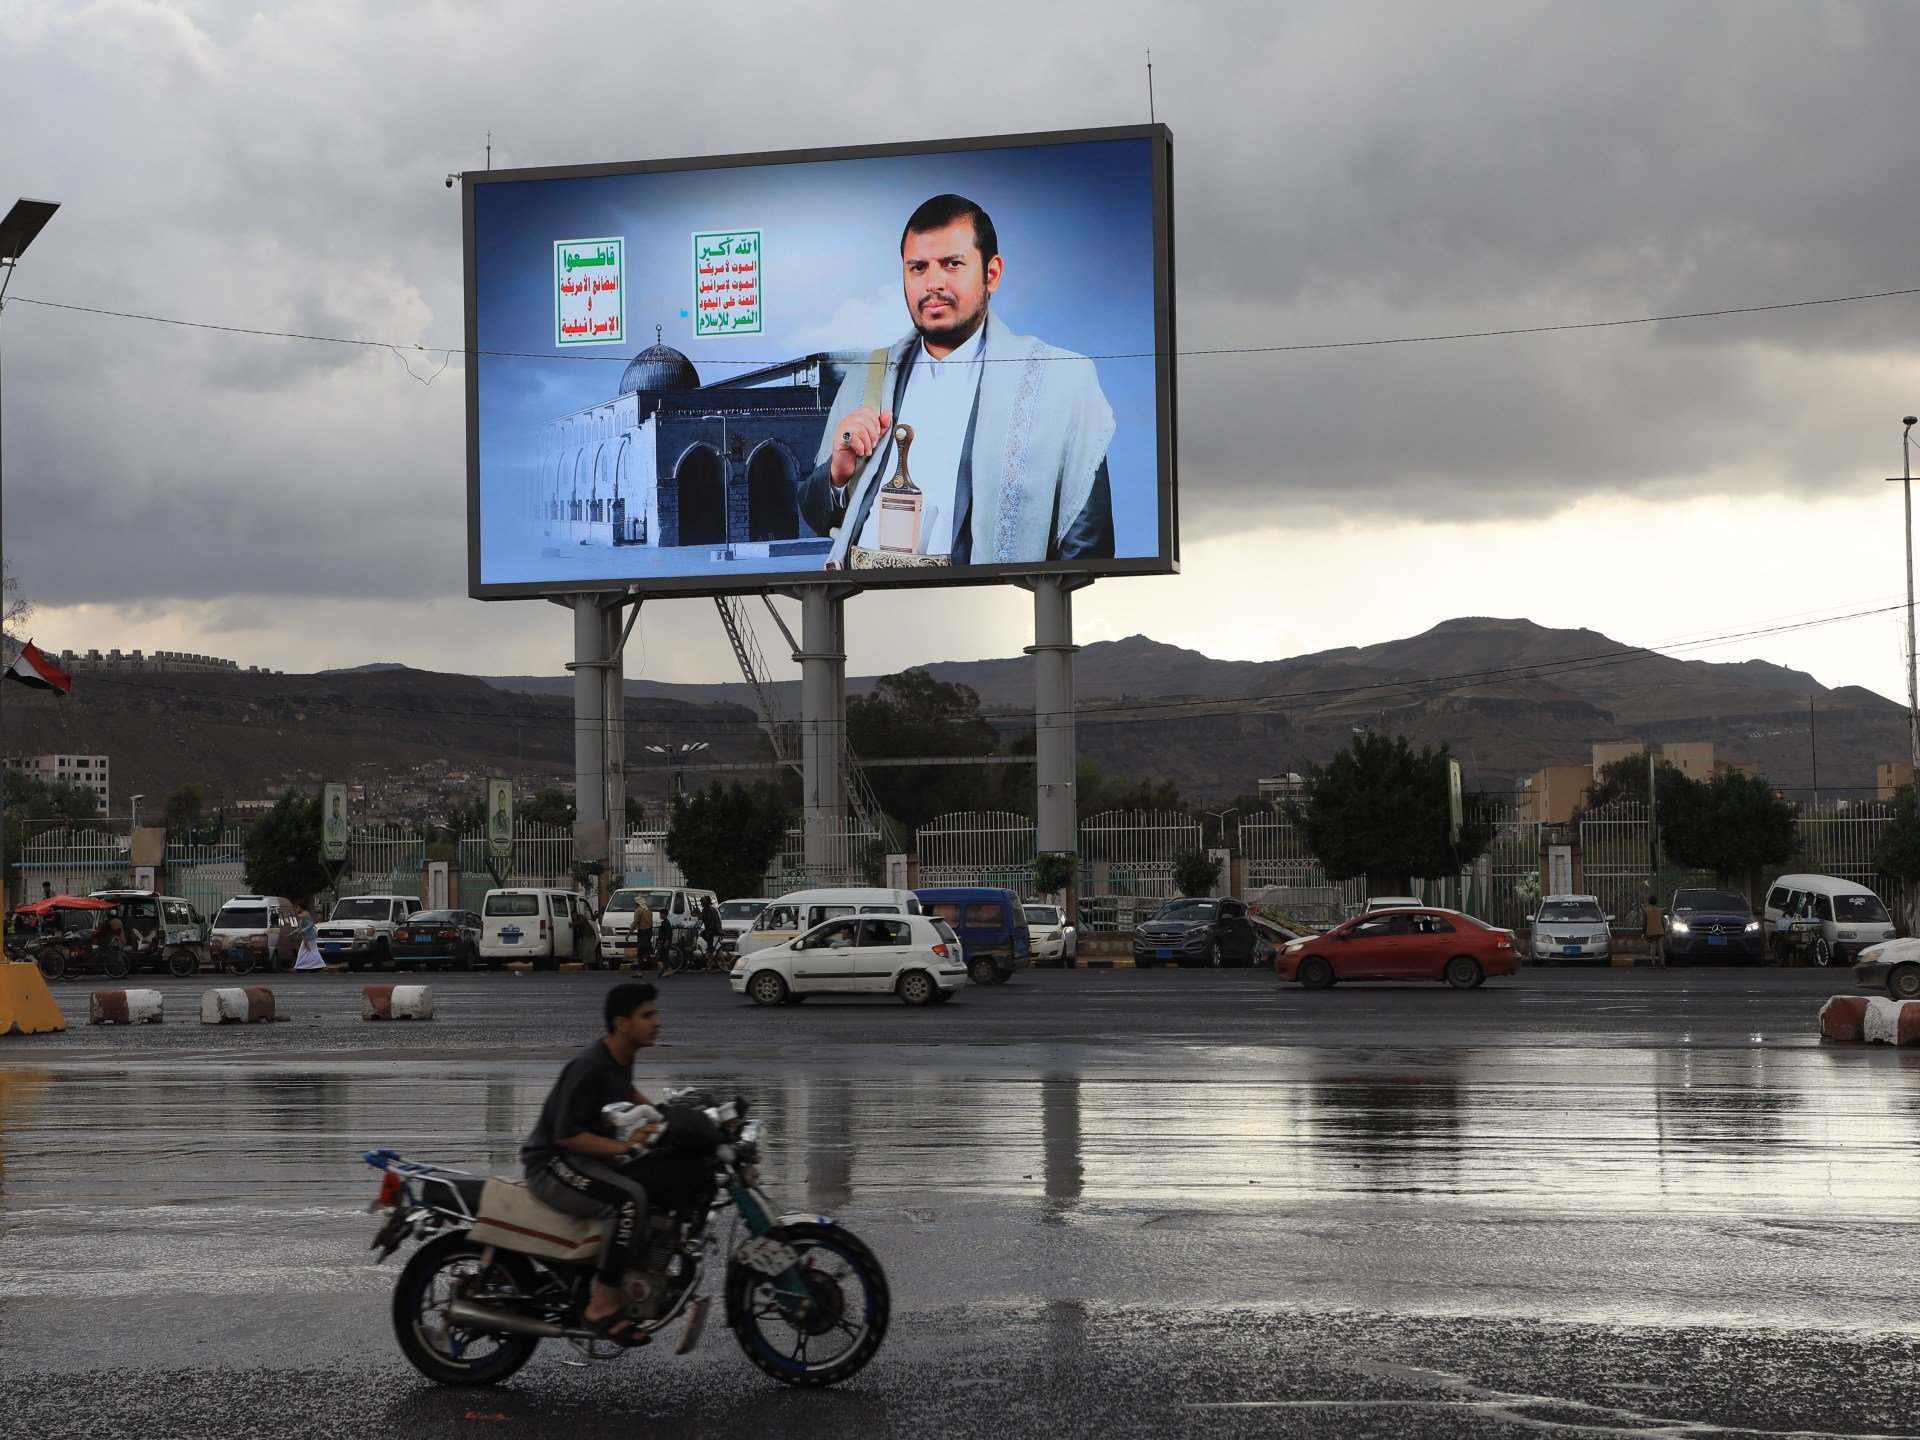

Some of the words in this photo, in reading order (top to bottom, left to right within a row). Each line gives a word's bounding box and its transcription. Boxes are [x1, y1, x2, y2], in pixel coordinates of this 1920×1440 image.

[699, 237, 734, 261] أكبر
[564, 246, 615, 273] قاطعوا
[731, 260, 757, 274] الموت
[593, 275, 619, 295] البضائع
[731, 278, 757, 291] الموت
[588, 296, 593, 311] و
[699, 297, 721, 310] اليهود
[723, 296, 735, 309] على
[562, 315, 619, 337] الإسرائيلية
[700, 312, 729, 331] للإسلام
[731, 309, 758, 329] النصر
